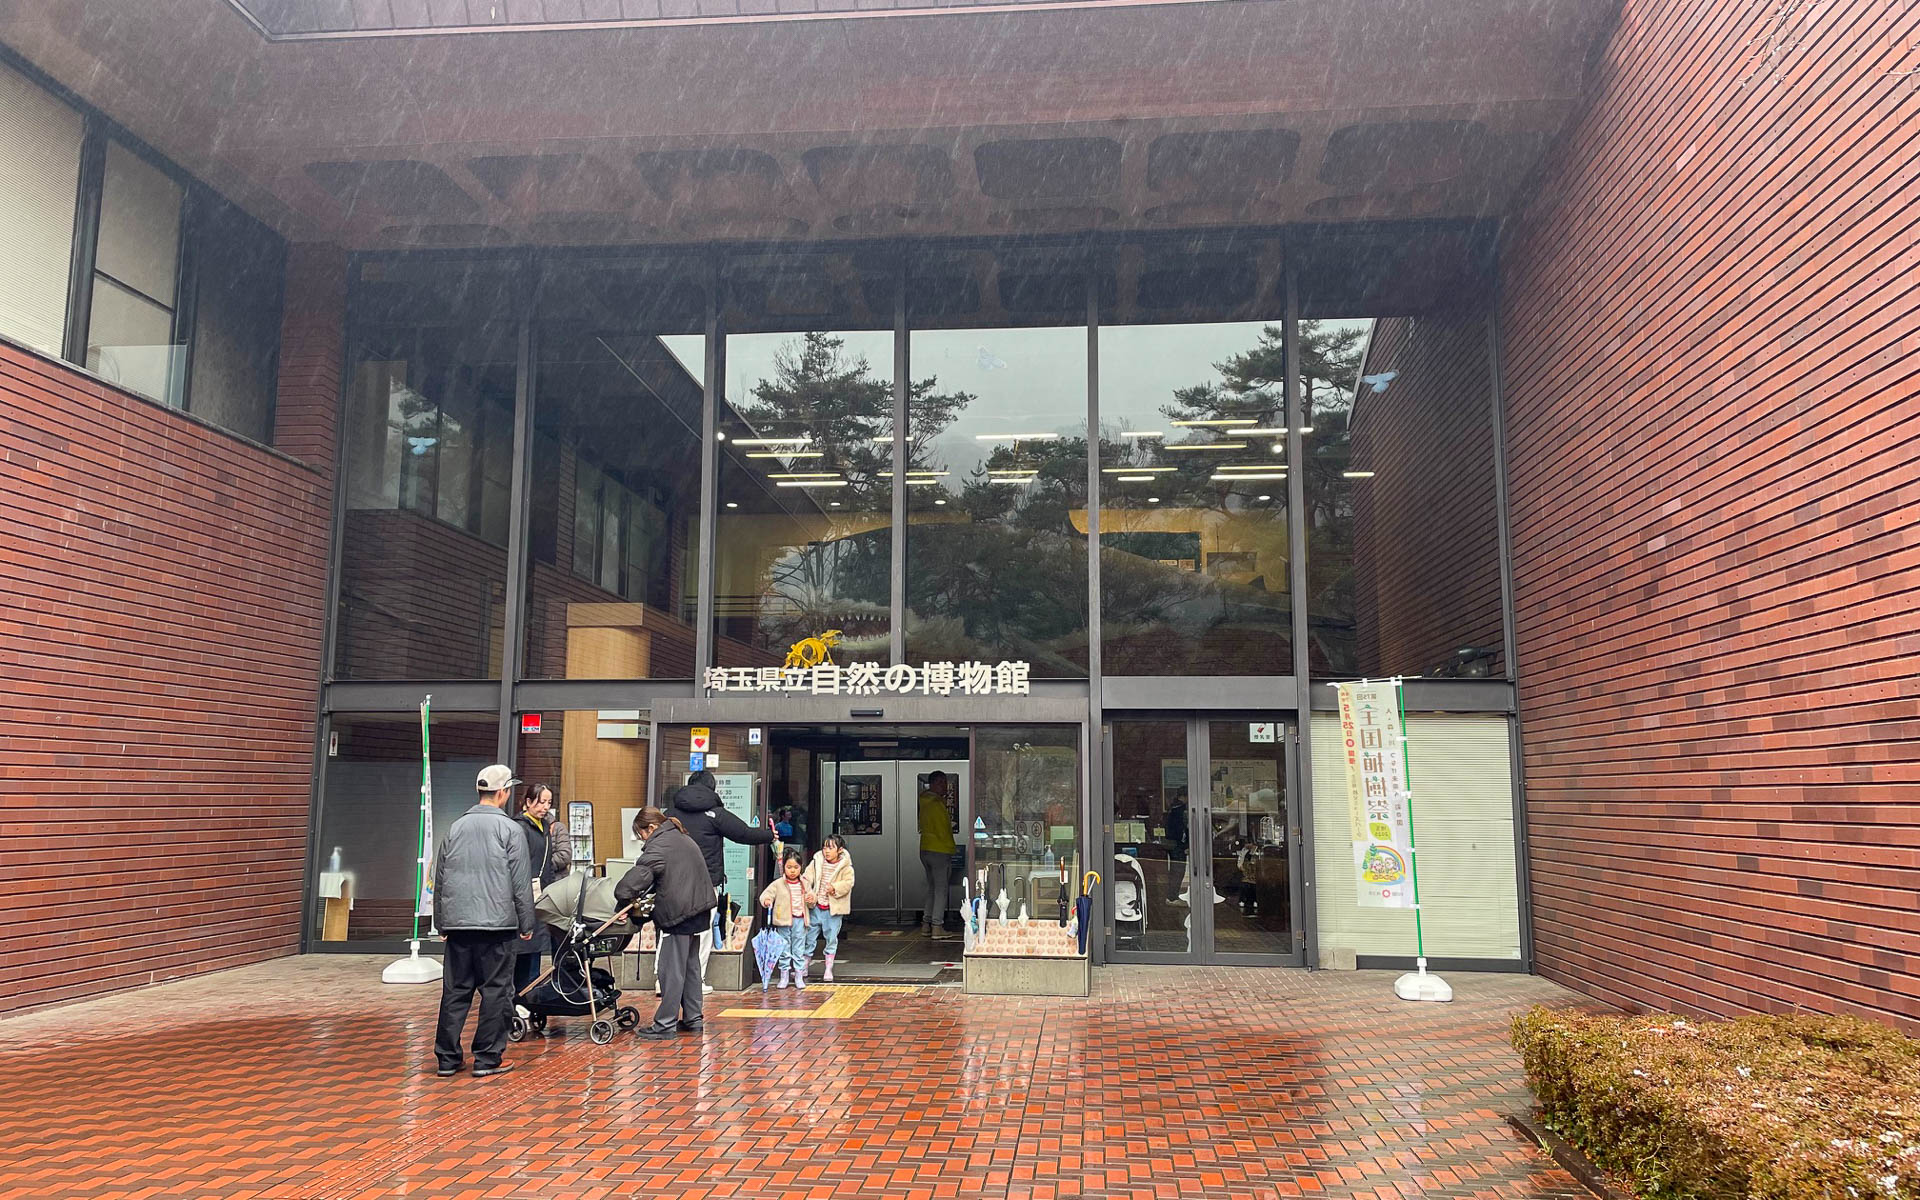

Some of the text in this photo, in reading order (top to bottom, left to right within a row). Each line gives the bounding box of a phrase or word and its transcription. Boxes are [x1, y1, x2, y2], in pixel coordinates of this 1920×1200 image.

[702, 660, 1031, 696] 埼玉県立自然の博物館
